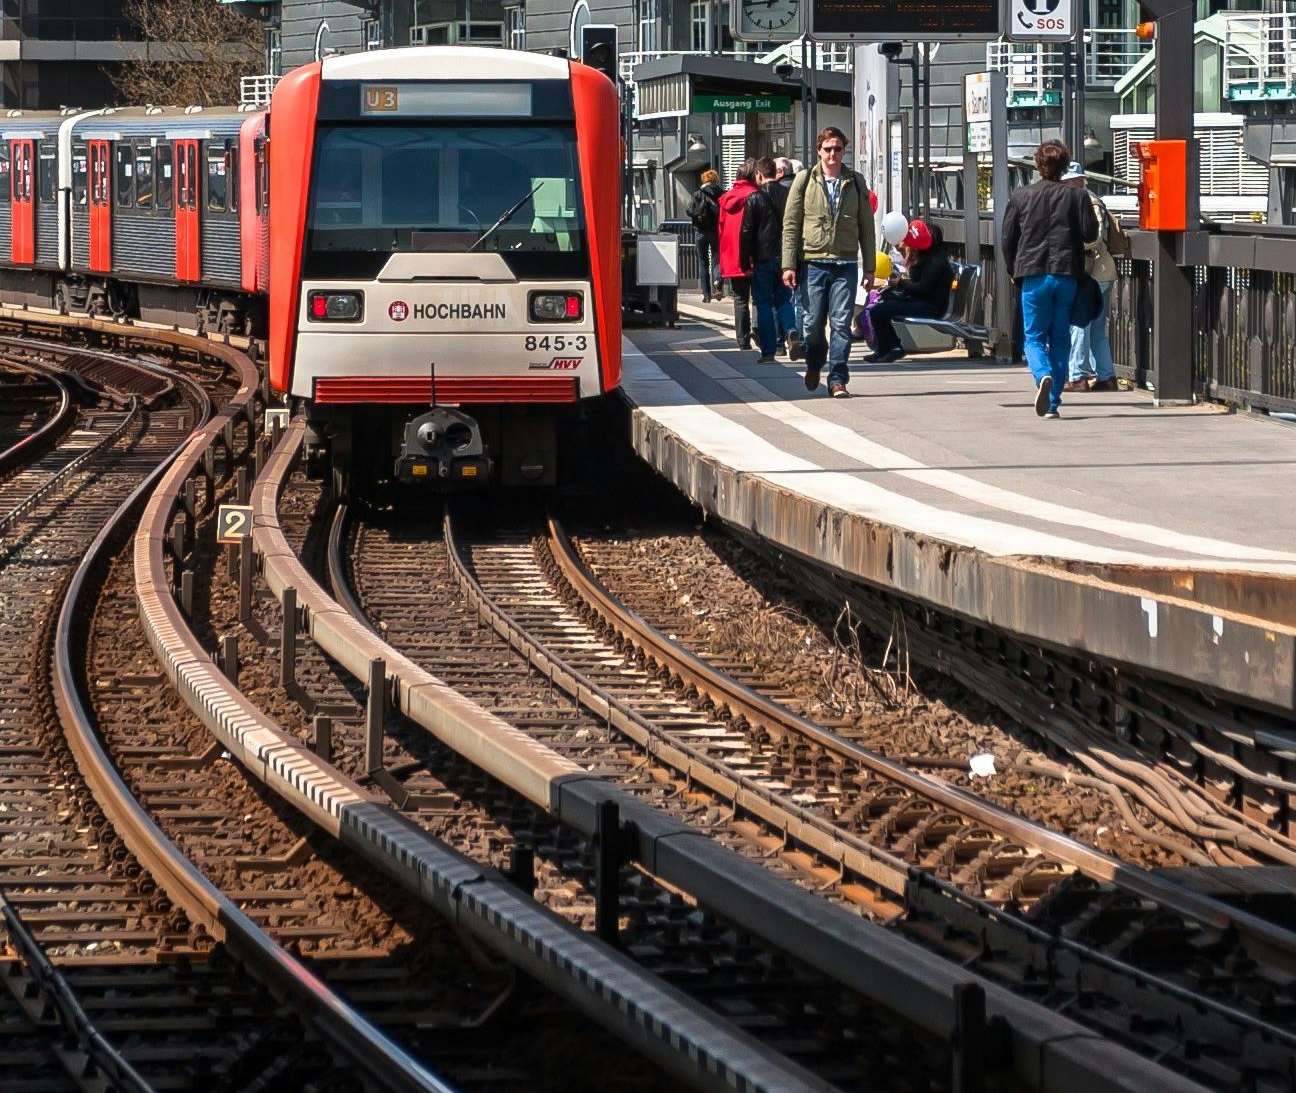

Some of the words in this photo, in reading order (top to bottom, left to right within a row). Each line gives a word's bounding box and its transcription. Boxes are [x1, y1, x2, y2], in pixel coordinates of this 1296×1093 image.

[1035, 18, 1065, 30] SOS
[713, 99, 753, 110] Ausgang
[755, 99, 772, 109] Exit
[413, 303, 506, 319] HOCHBAHN
[524, 335, 587, 352] 845-3
[553, 359, 582, 370] HVV
[225, 510, 246, 538] 2
